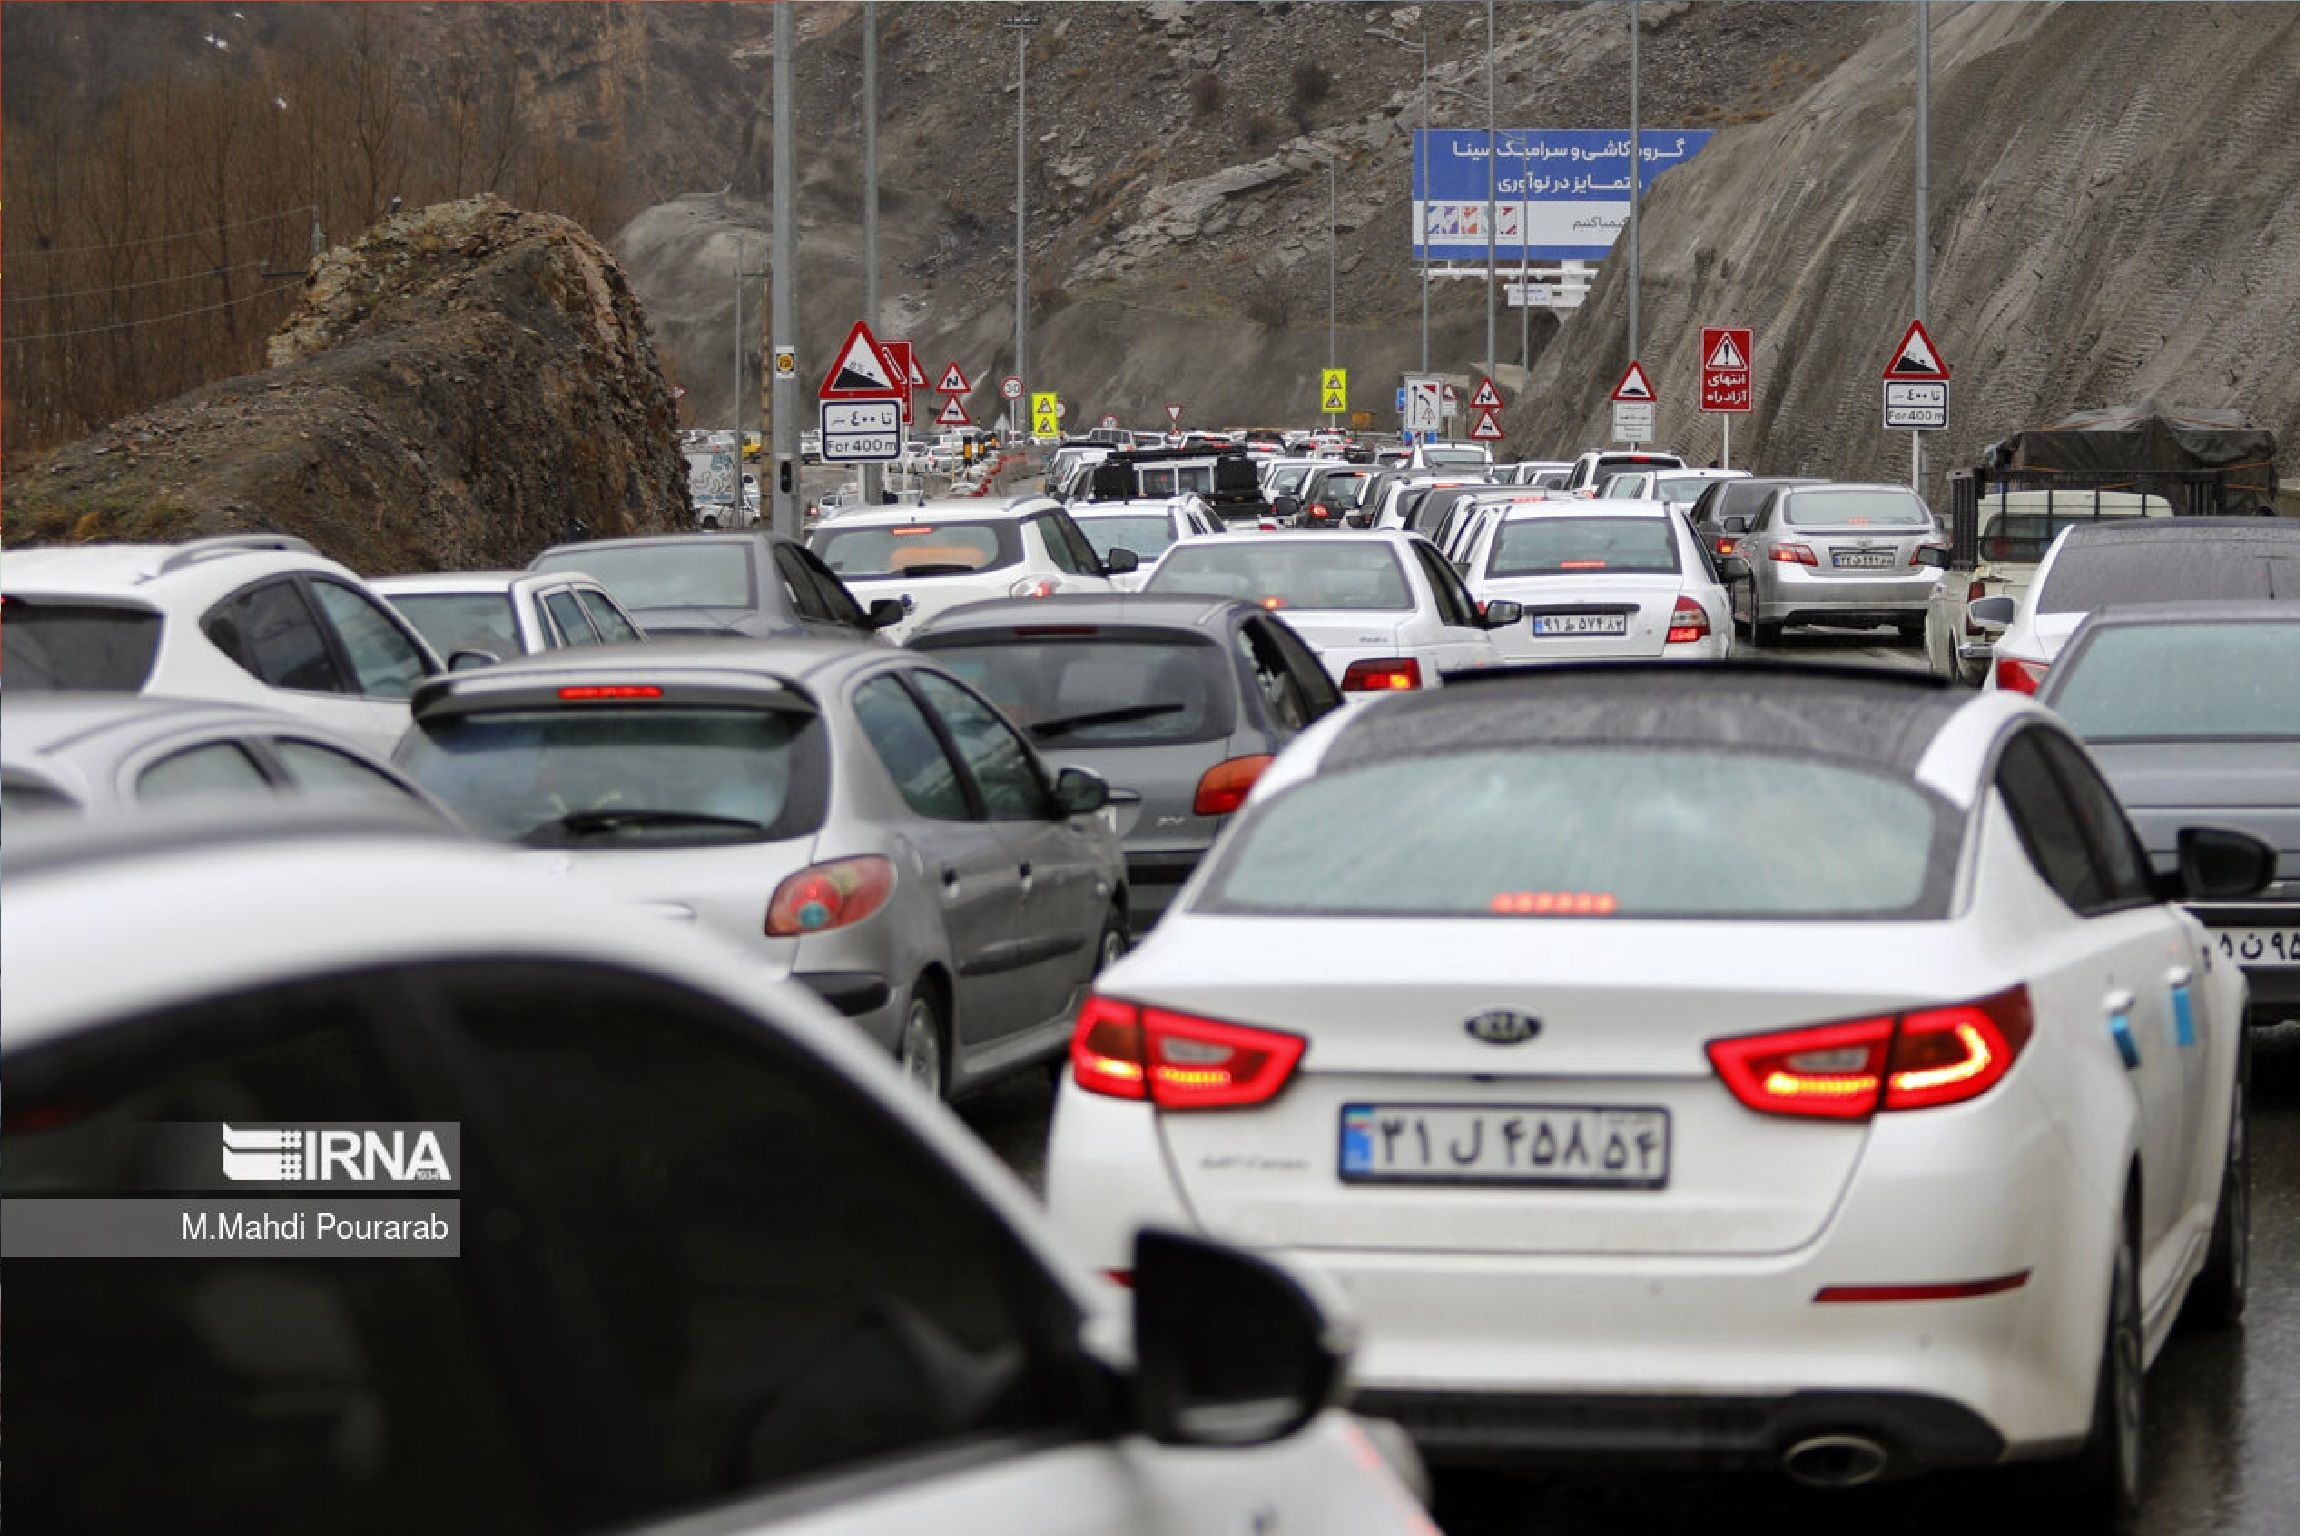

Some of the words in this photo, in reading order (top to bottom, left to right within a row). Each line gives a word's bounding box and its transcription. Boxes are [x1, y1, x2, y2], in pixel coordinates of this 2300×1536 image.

[1496, 139, 1569, 161] سرامیک
[1571, 147, 1580, 161] و
[1581, 139, 1631, 161] کاشی
[1707, 374, 1746, 388] انتهای
[881, 411, 893, 425] تا
[1908, 410, 1932, 421] 400
[829, 440, 850, 453] For
[852, 439, 883, 453] 400
[885, 440, 896, 452] m
[2241, 932, 2264, 960] ن
[1450, 1117, 1484, 1165] ل
[1502, 1118, 1588, 1166] ۴۵۸
